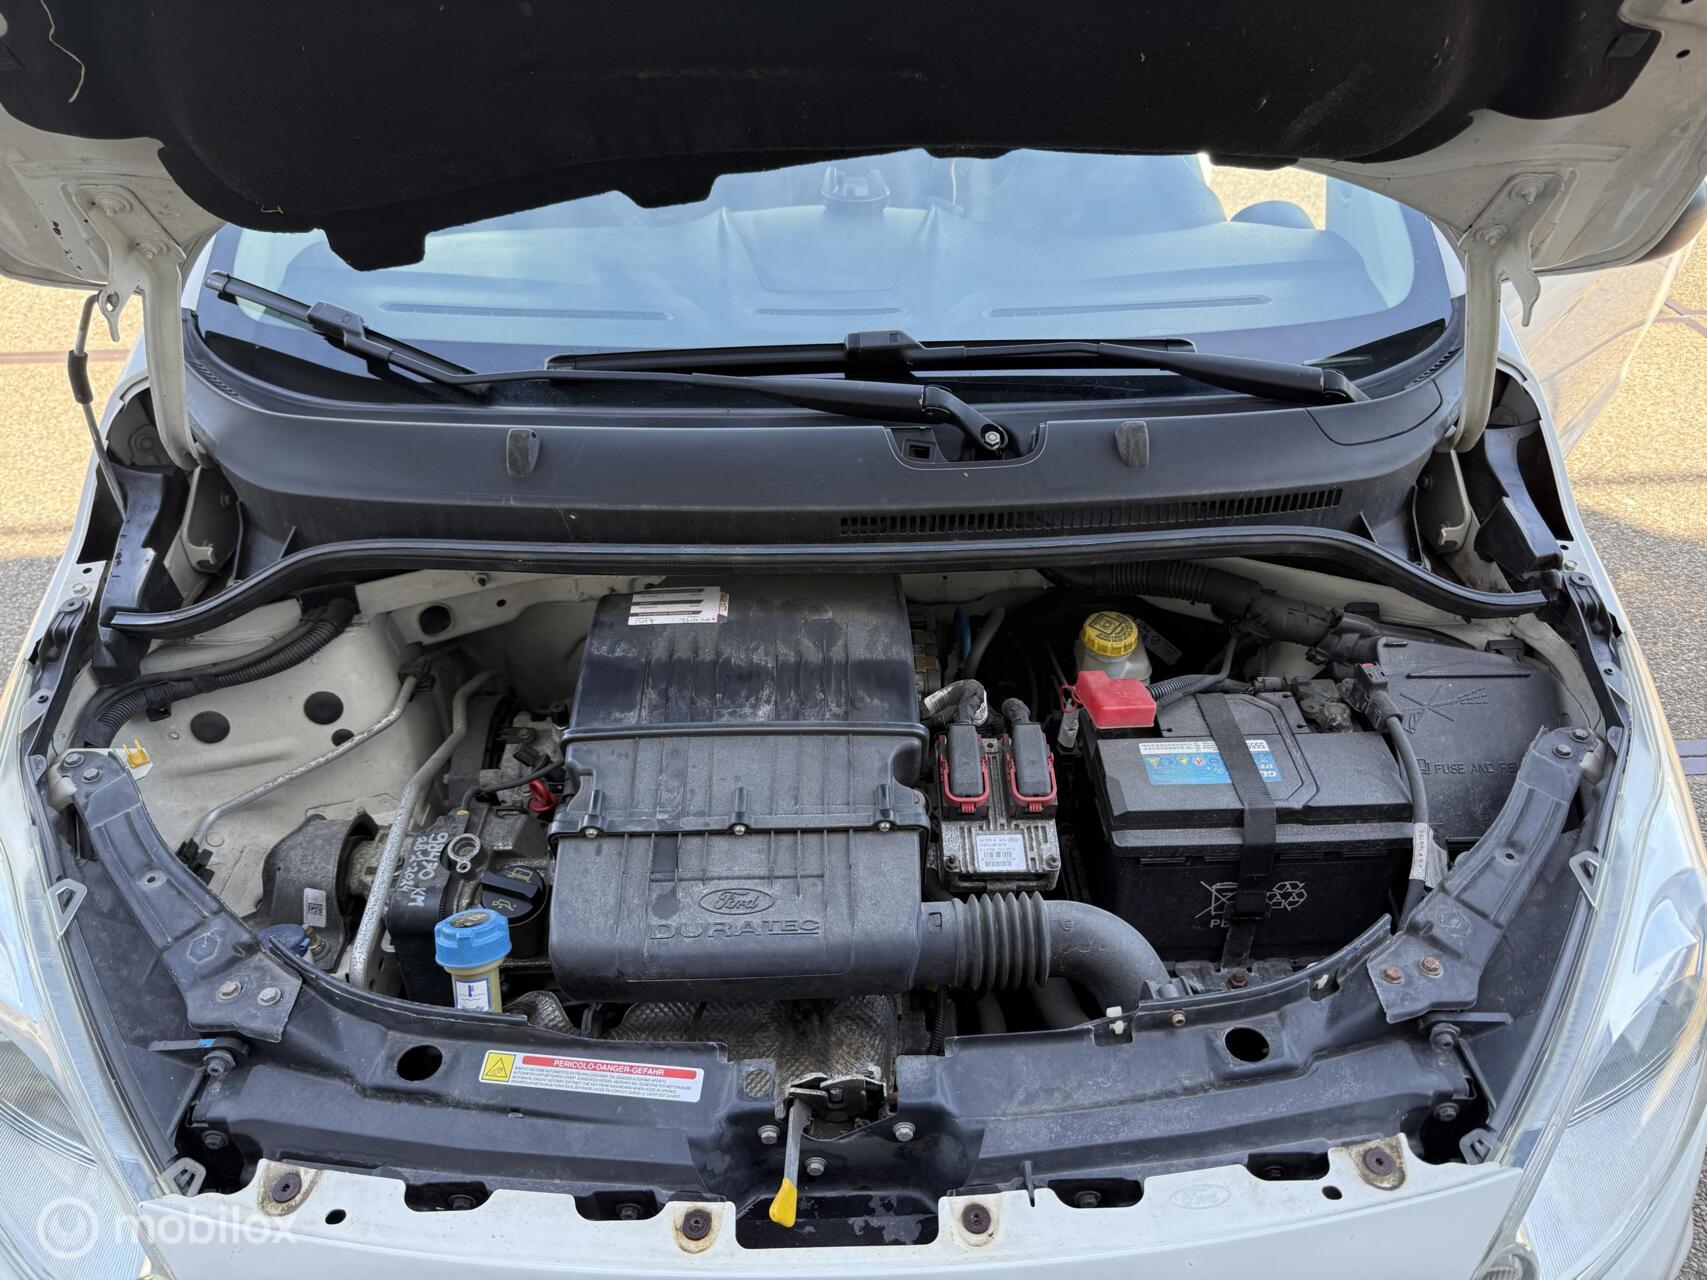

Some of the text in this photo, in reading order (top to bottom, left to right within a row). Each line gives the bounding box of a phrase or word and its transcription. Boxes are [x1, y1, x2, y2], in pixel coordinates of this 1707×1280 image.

[1434, 762, 1465, 775] FUSE
[1470, 762, 1495, 774] AND
[407, 886, 427, 908] KM
[713, 890, 760, 910] Ford
[649, 919, 820, 940] DURATEC
[553, 1059, 664, 1076] PERICOLO-DANGER-GEFAHR
